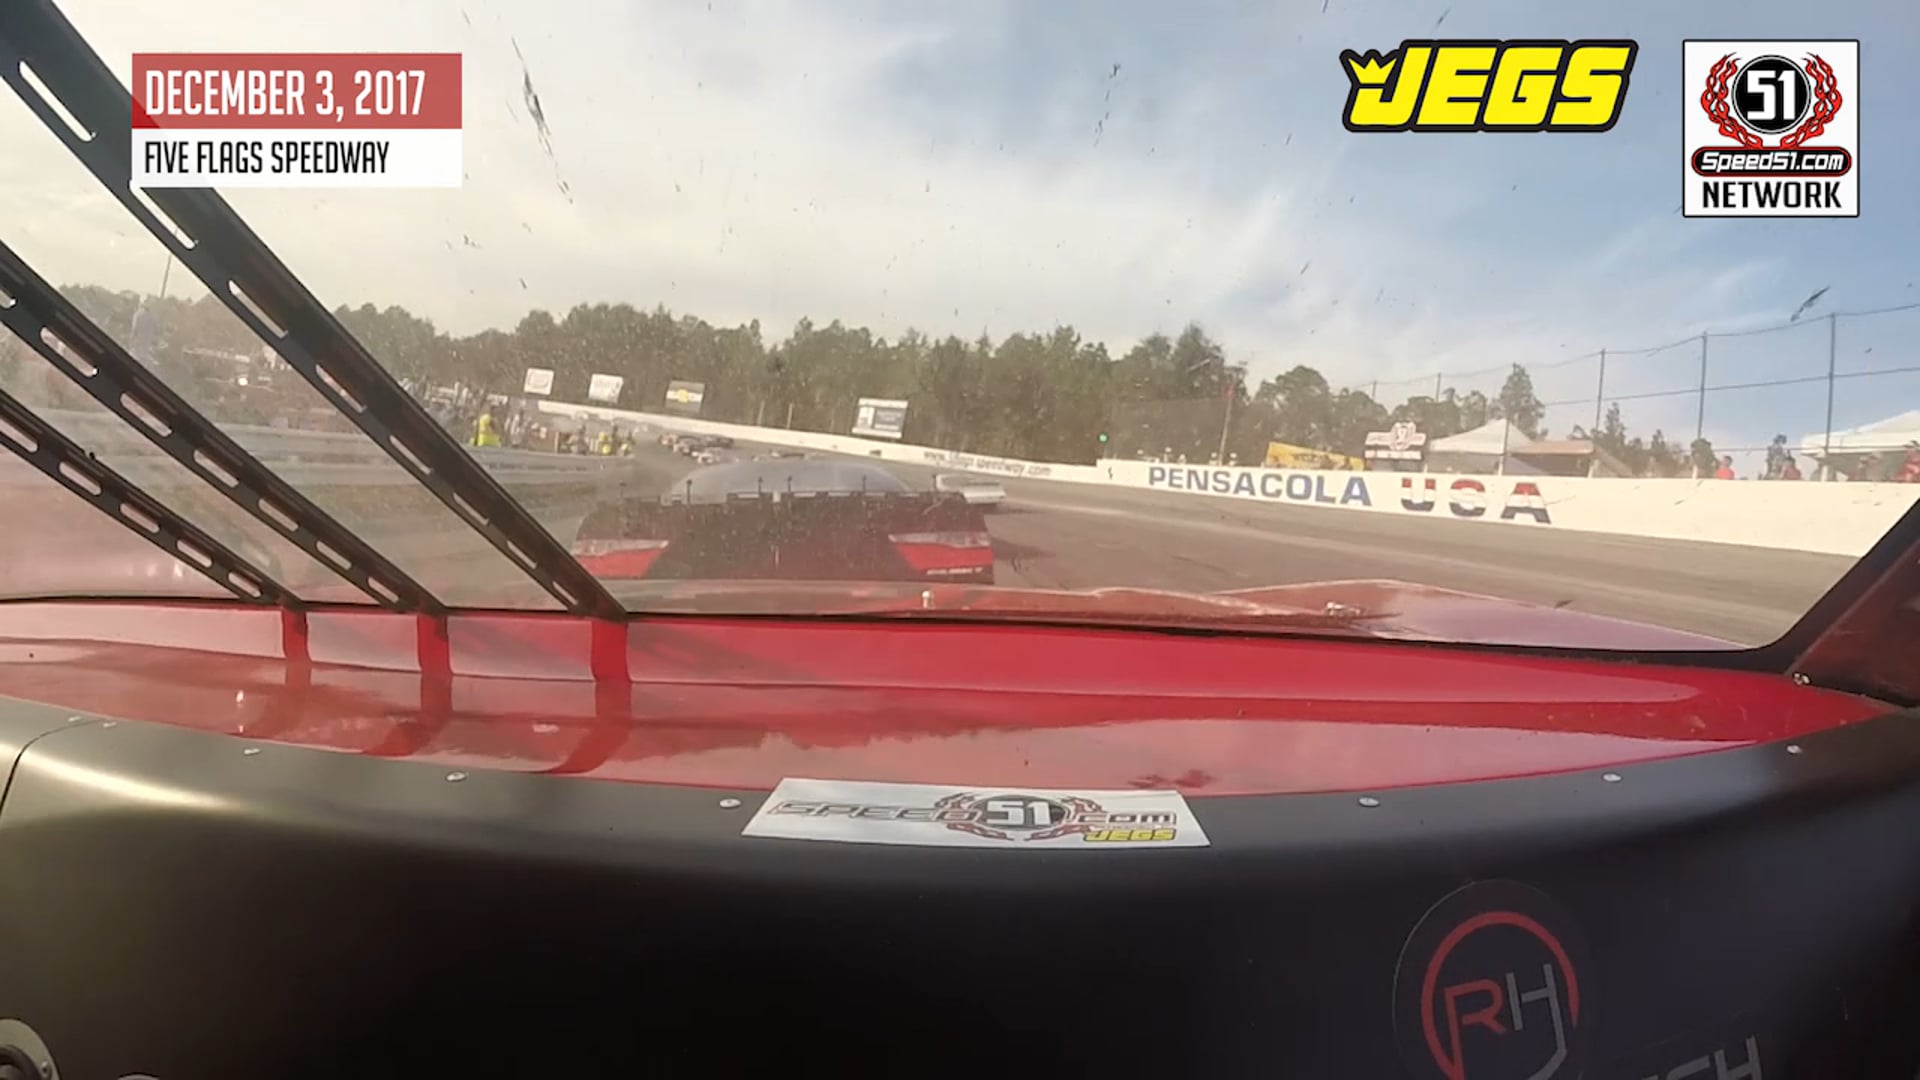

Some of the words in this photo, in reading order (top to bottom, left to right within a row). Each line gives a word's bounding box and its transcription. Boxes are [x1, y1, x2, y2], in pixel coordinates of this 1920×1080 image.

[1147, 465, 1373, 508] PENSACOLA
[1399, 476, 1553, 525] USA
[1082, 827, 1177, 842] JEGS
